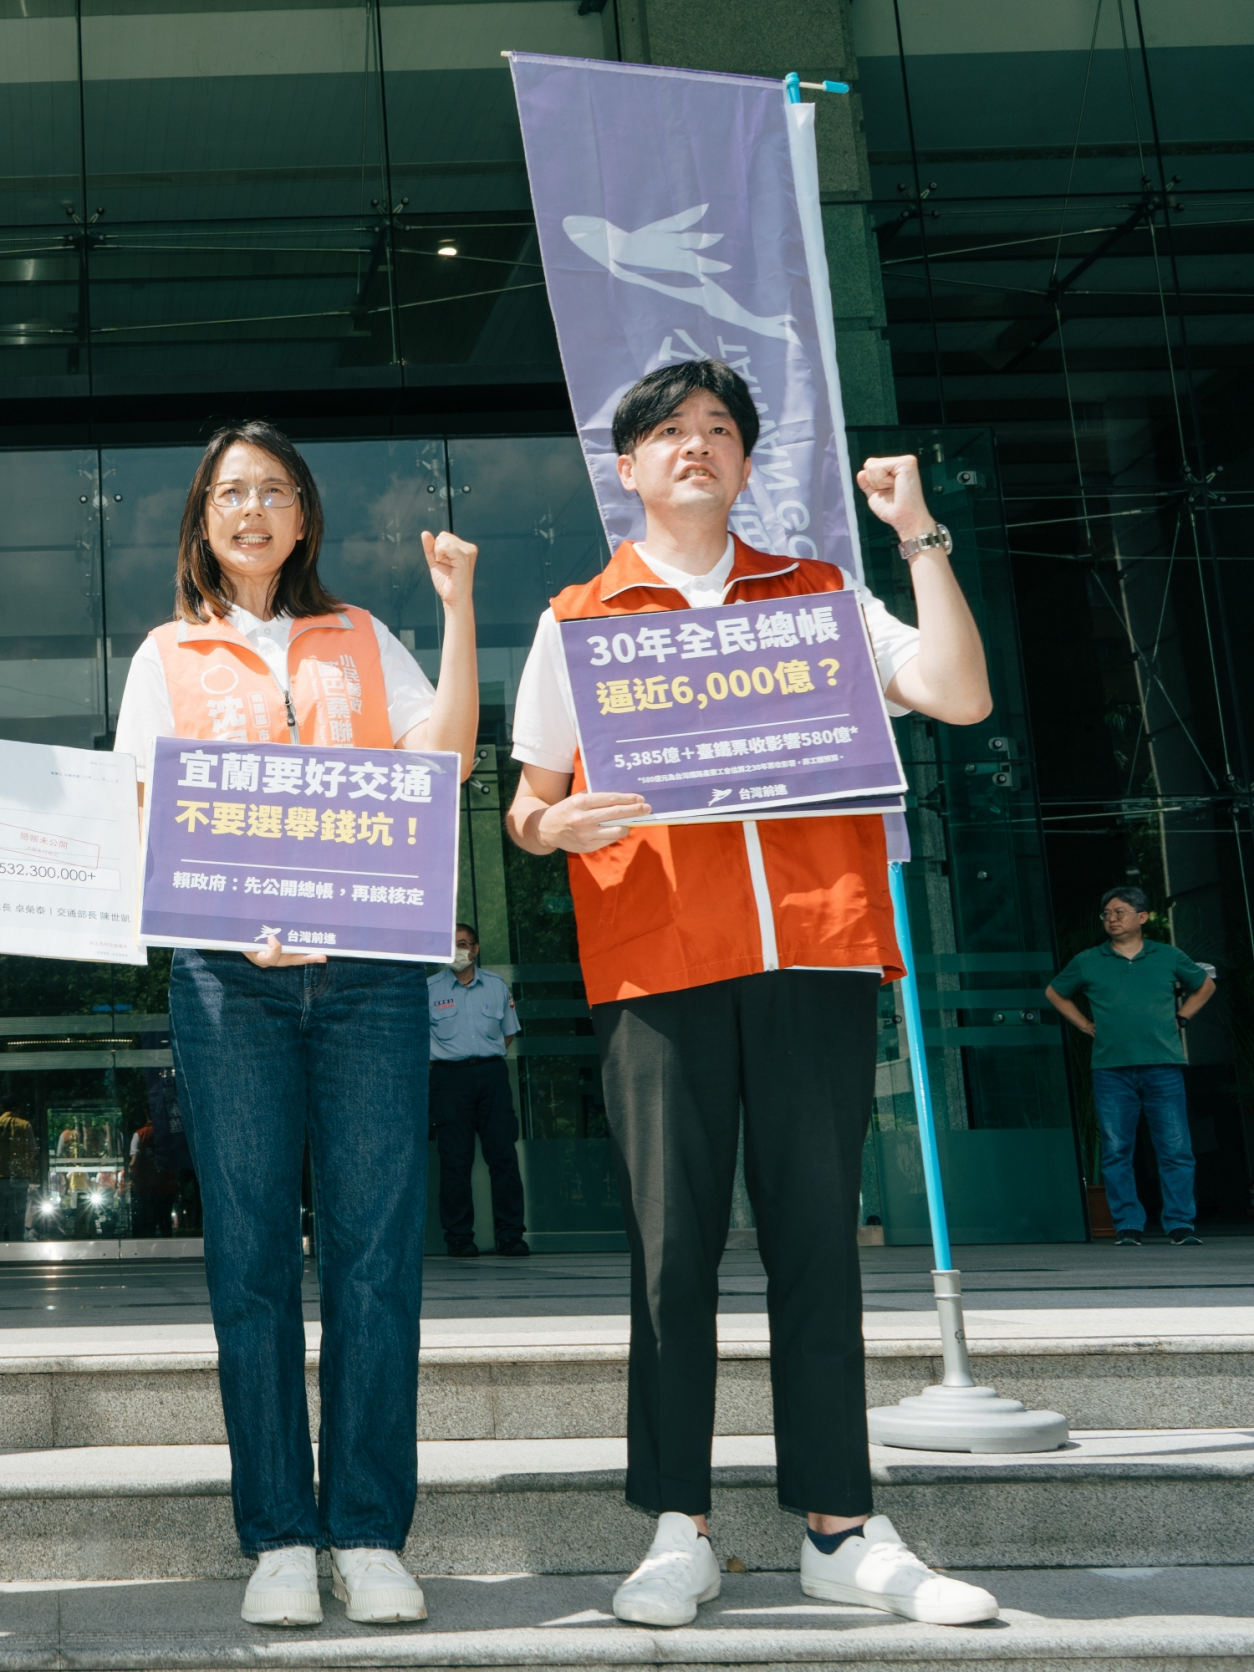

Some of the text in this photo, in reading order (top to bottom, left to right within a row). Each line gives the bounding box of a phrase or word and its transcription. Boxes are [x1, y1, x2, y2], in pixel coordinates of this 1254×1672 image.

[587, 606, 840, 666] 30年全民總帳
[315, 661, 354, 748] 歐巴桑聯
[596, 658, 841, 716] 逼近6,000億？
[177, 749, 433, 804] 宜蘭要好交通
[739, 783, 789, 801] 台灣前進
[175, 800, 418, 846] 不要選舉錢坑！
[173, 871, 424, 906] 賴政府：先公開總帳，再談核定
[56, 908, 97, 921] 交通部長
[287, 929, 337, 945] 台灣前進
